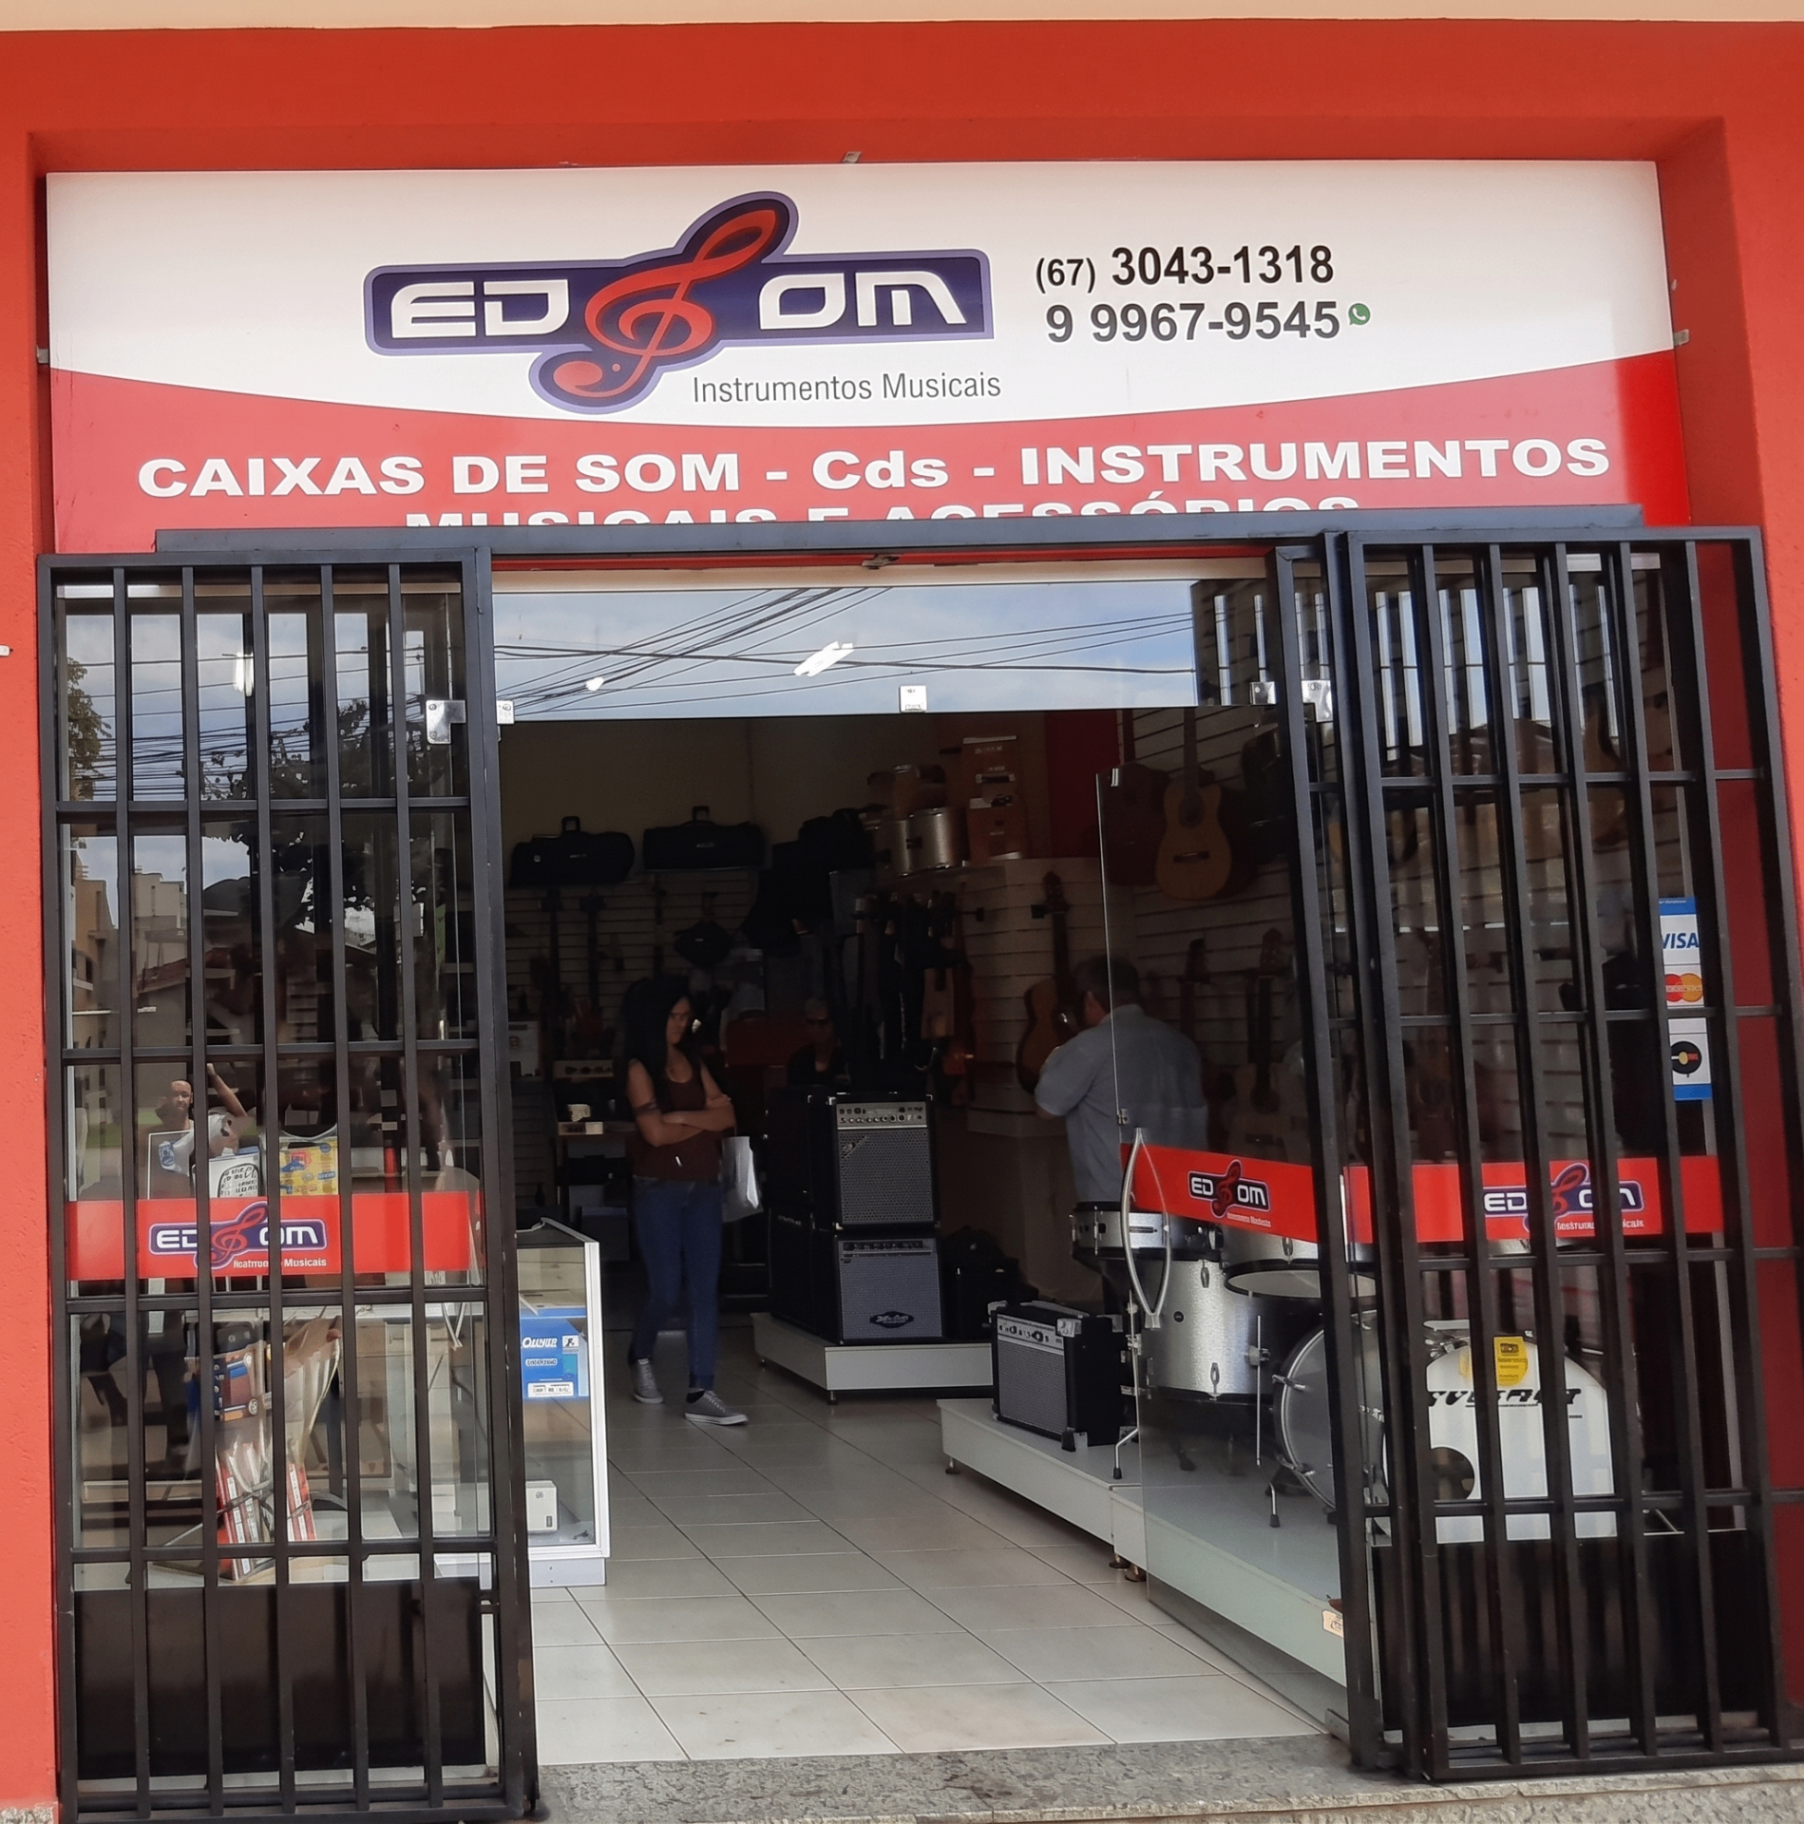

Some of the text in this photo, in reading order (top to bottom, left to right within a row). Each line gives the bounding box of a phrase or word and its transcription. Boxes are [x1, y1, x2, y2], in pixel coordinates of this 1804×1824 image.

[1036, 245, 1334, 293] (67) 3043-1318
[1046, 301, 1340, 342] 9 9967-9545
[693, 371, 1001, 402] Instrumentos Musicais
[138, 456, 425, 497] CAIXAS
[452, 455, 548, 494] DE
[575, 453, 739, 492] SOM
[812, 450, 949, 489] Cds
[1021, 438, 1609, 485] INSTRUMENTOS
